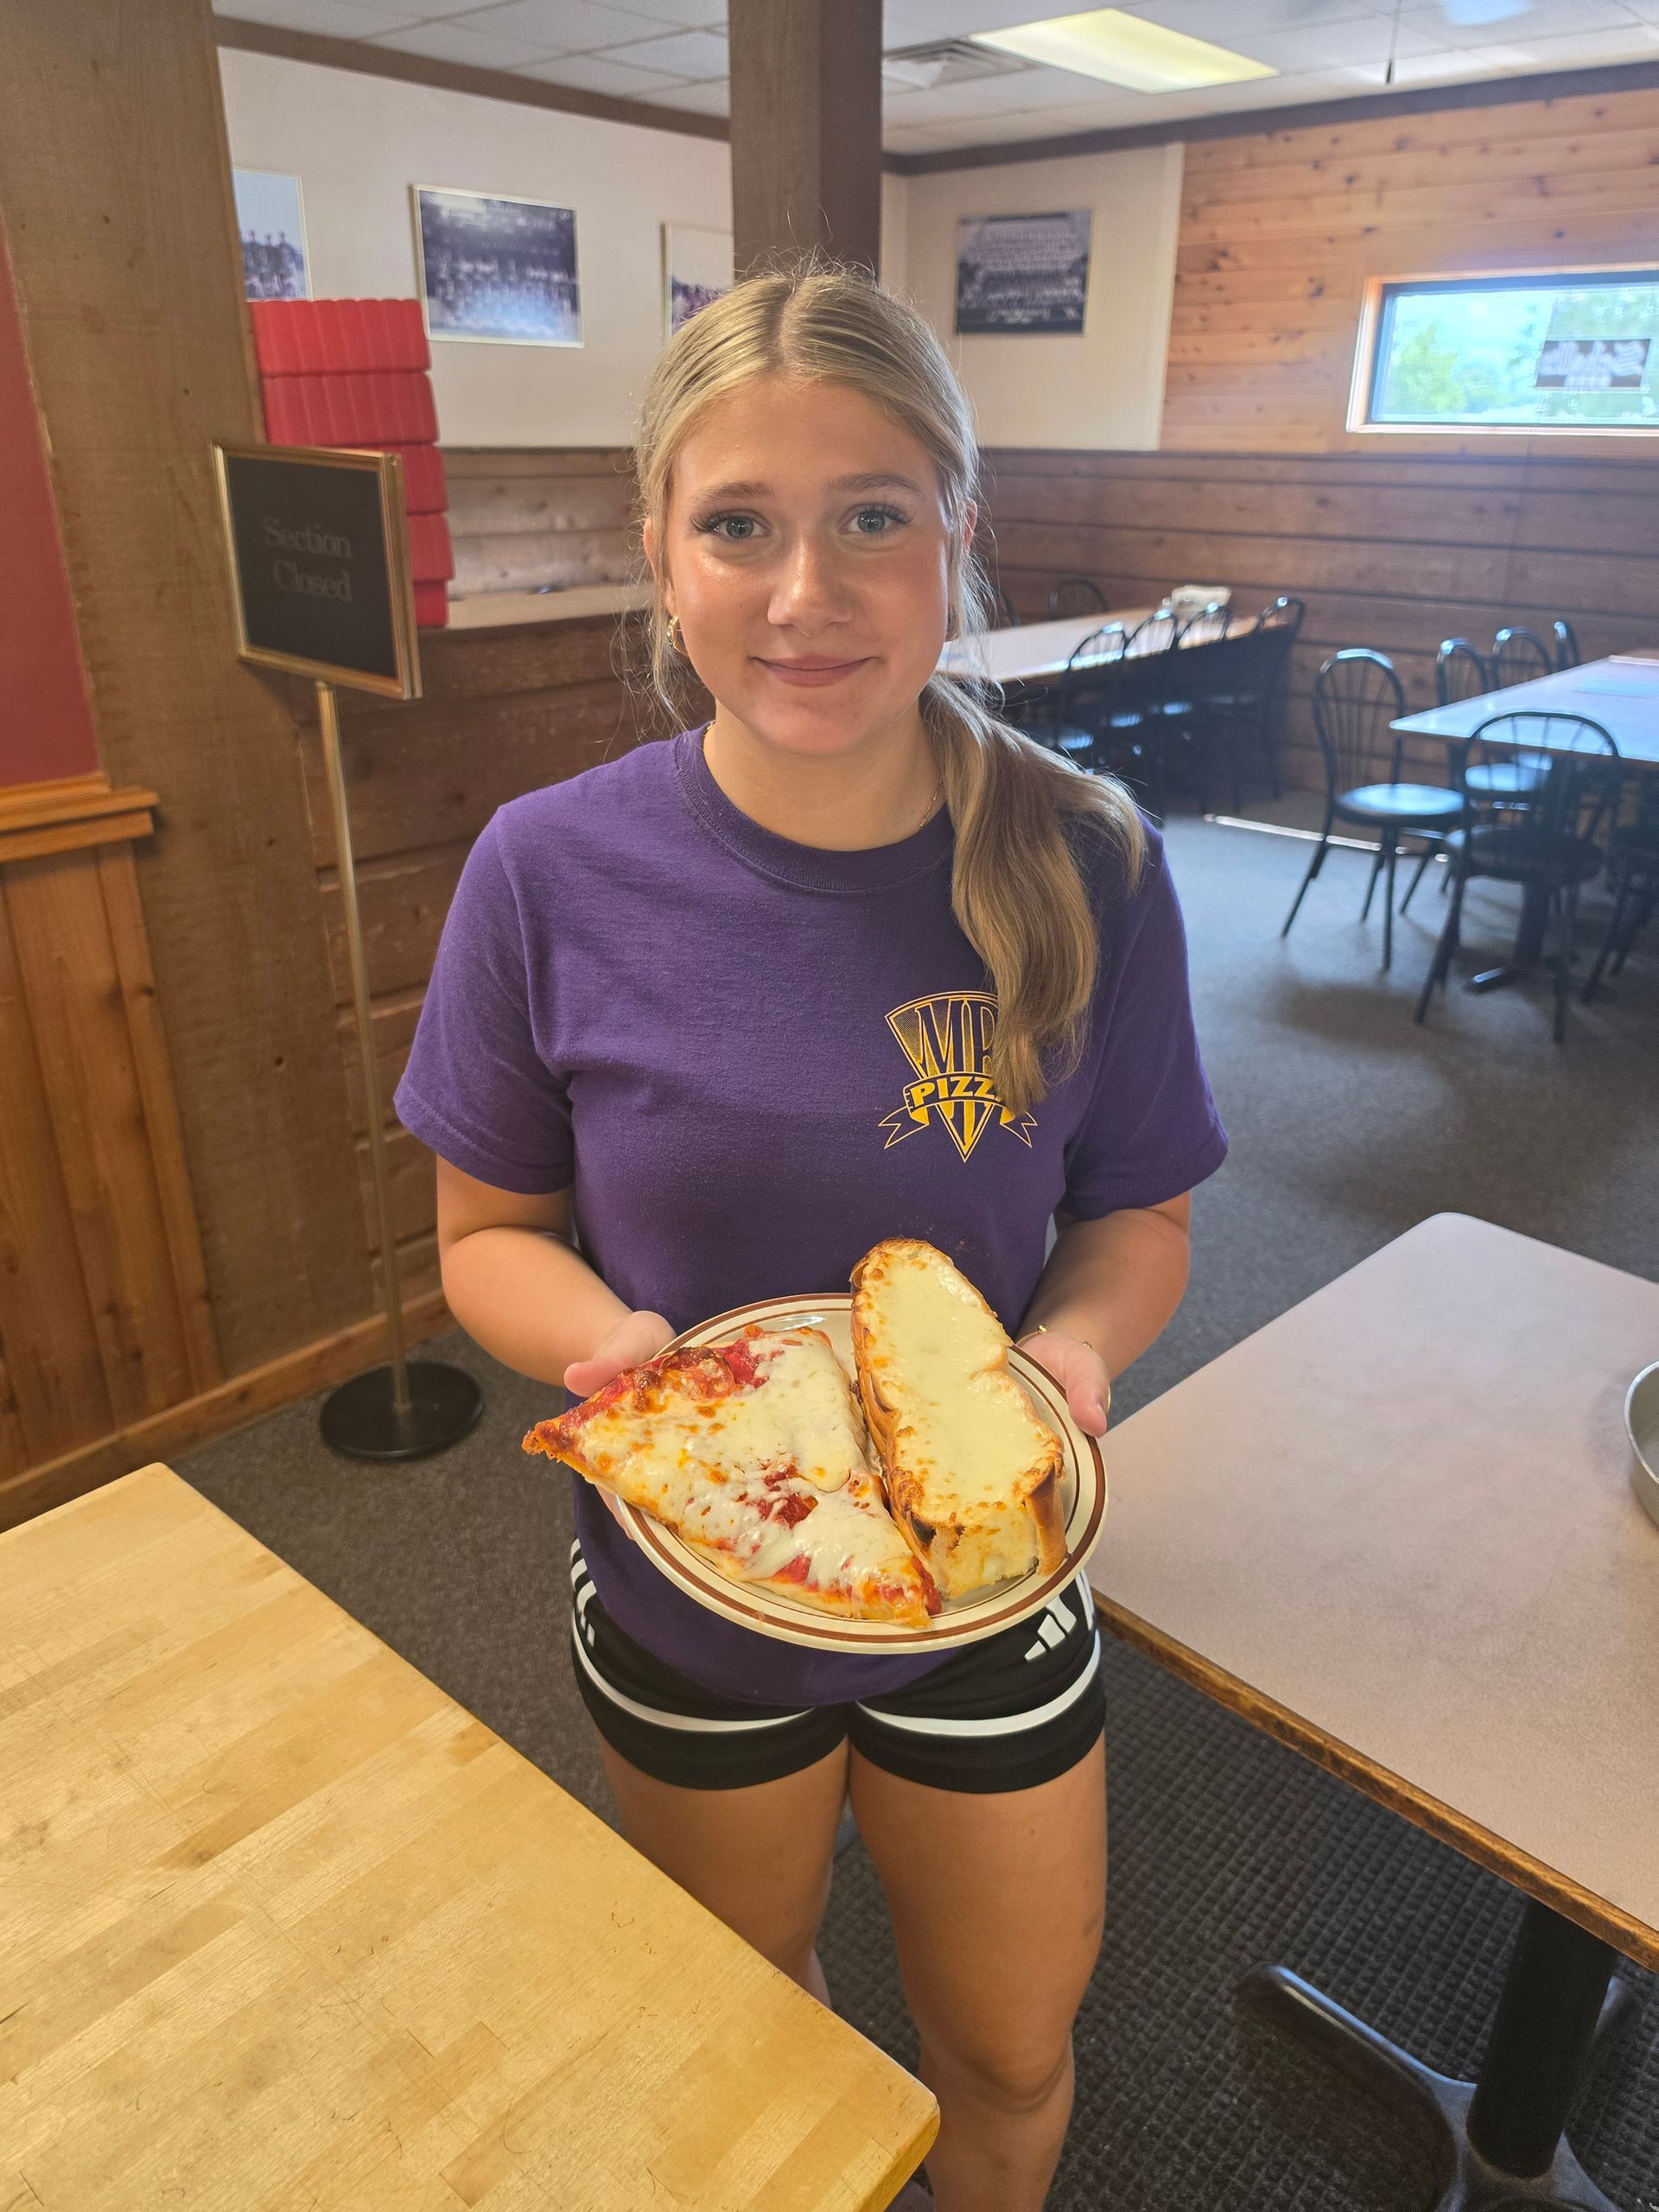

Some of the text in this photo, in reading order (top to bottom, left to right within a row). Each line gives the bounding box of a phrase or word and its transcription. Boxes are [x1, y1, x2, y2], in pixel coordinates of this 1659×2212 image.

[263, 515, 353, 559] Section
[272, 558, 353, 603] Closed
[910, 1076, 1001, 1108] PIZZ
